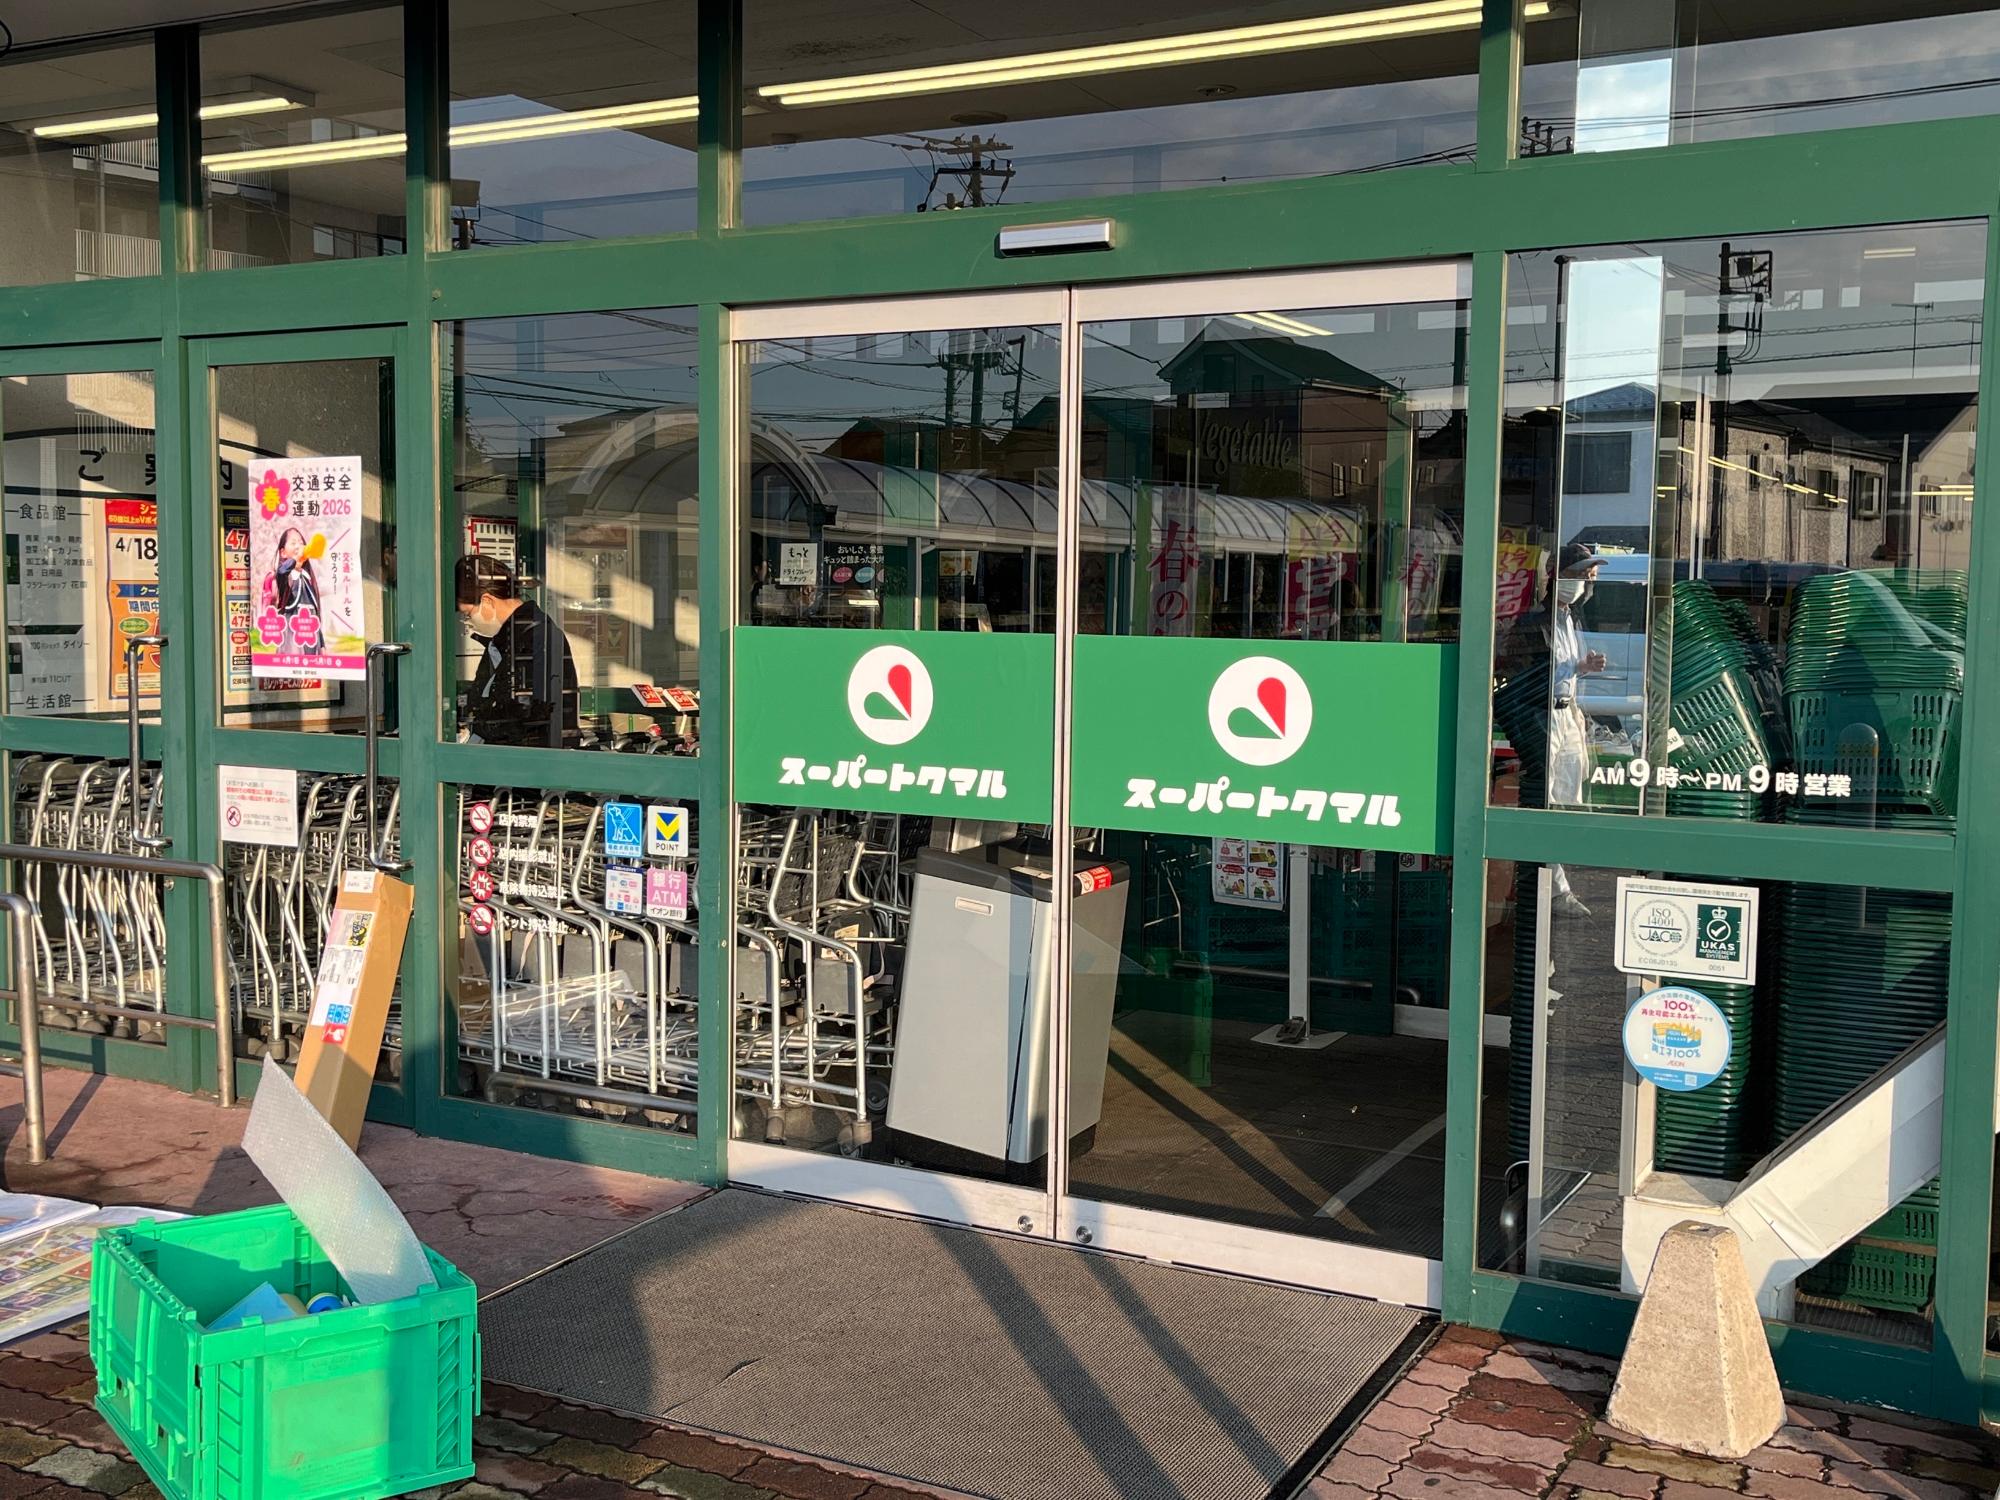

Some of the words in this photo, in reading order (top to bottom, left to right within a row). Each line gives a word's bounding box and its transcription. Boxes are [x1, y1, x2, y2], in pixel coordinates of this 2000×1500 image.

[292, 473, 352, 491] 交通安全
[19, 503, 67, 521] 食品館
[115, 537, 158, 560] 4/18
[342, 552, 353, 617] 交通ルールを
[1147, 520, 1202, 635] 春の
[63, 640, 90, 649] ダイソー
[26, 693, 72, 710] 生活館
[778, 754, 1008, 799] スーパートクマル
[1123, 776, 1402, 827] スーパートクマル
[656, 843, 680, 852] POINT
[652, 871, 683, 890] 銀行
[652, 889, 683, 905] ATM
[649, 907, 684, 919] イオン銀行
[1651, 907, 1671, 918] ISO
[1646, 915, 1675, 928] 14001
[1699, 948, 1737, 957] MANAGEMENT
[1701, 940, 1736, 952] UKAS
[1663, 1000, 1695, 1013] 100%
